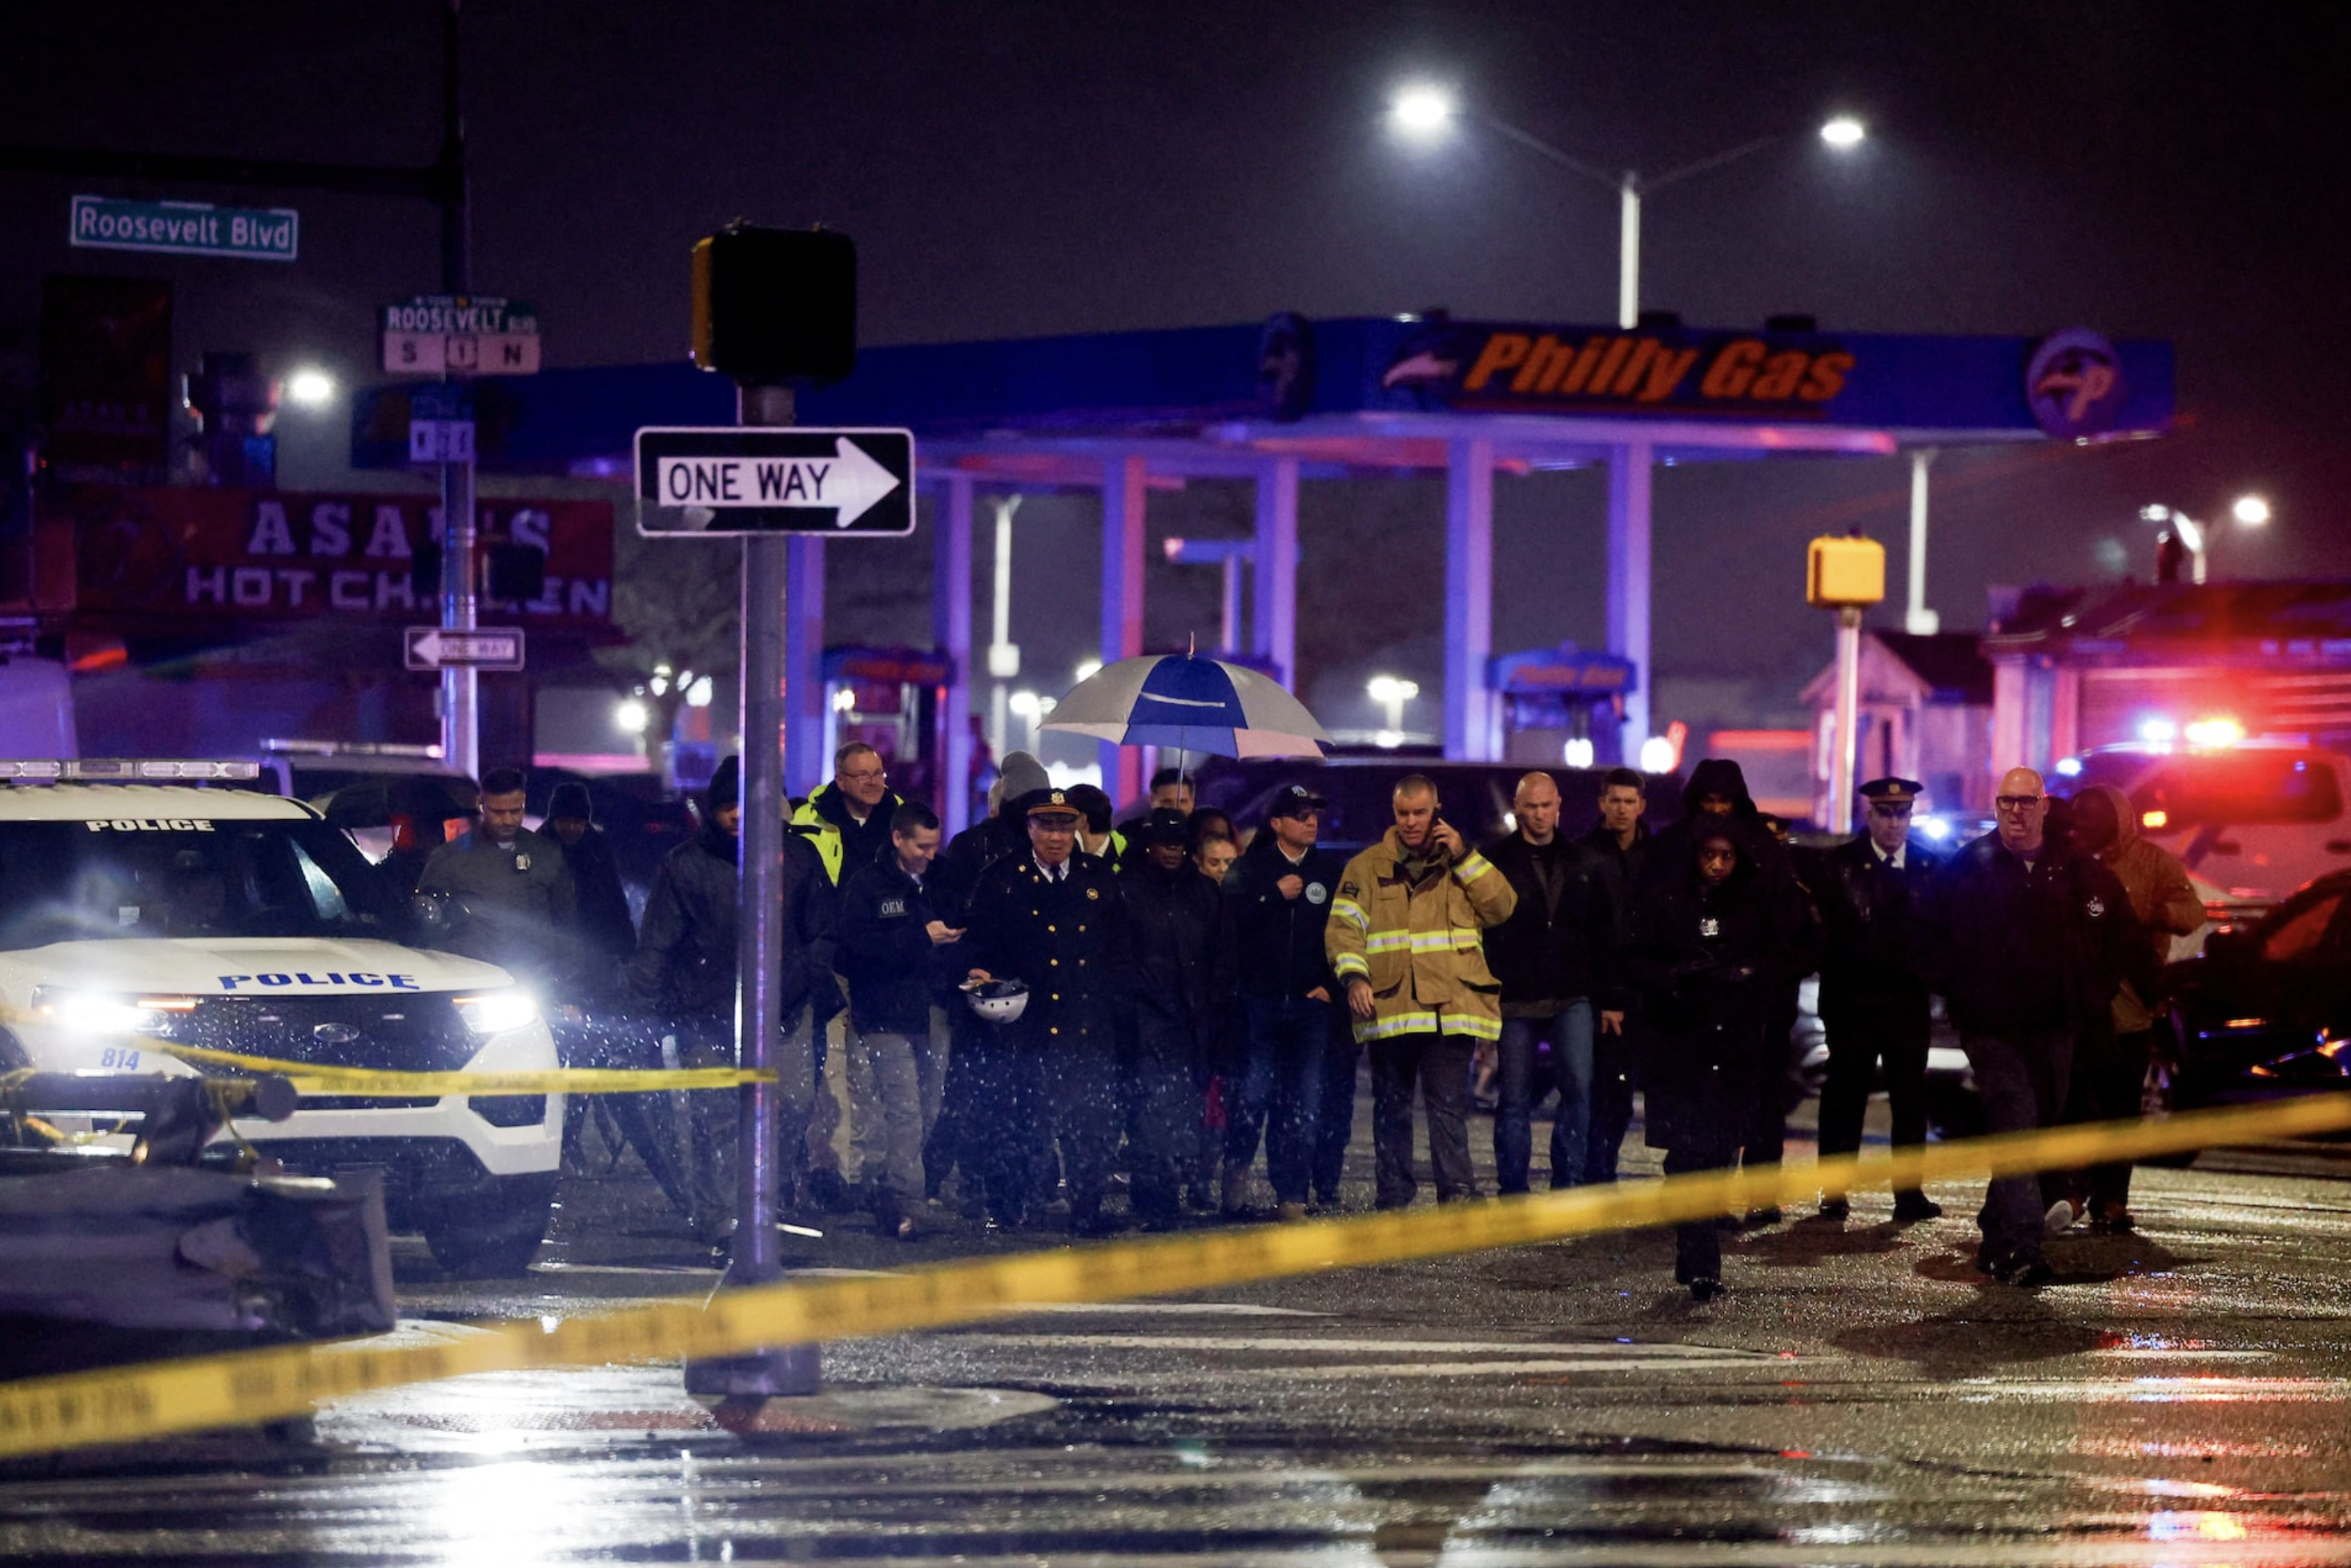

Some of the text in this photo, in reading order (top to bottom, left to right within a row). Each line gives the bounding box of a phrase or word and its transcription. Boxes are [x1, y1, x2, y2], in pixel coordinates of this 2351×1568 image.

[80, 207, 290, 249] Roosevelt Blvd
[388, 306, 503, 333] ROOSEVELT
[402, 341, 417, 363] S
[504, 342, 521, 364] N
[1463, 333, 1856, 401] Philly Gas
[669, 463, 831, 501] ONE WAY
[186, 567, 315, 606] HOT
[85, 819, 216, 833] POLICE
[882, 901, 905, 914] OEM
[218, 972, 421, 991] POLICE
[101, 1047, 140, 1071] 814
